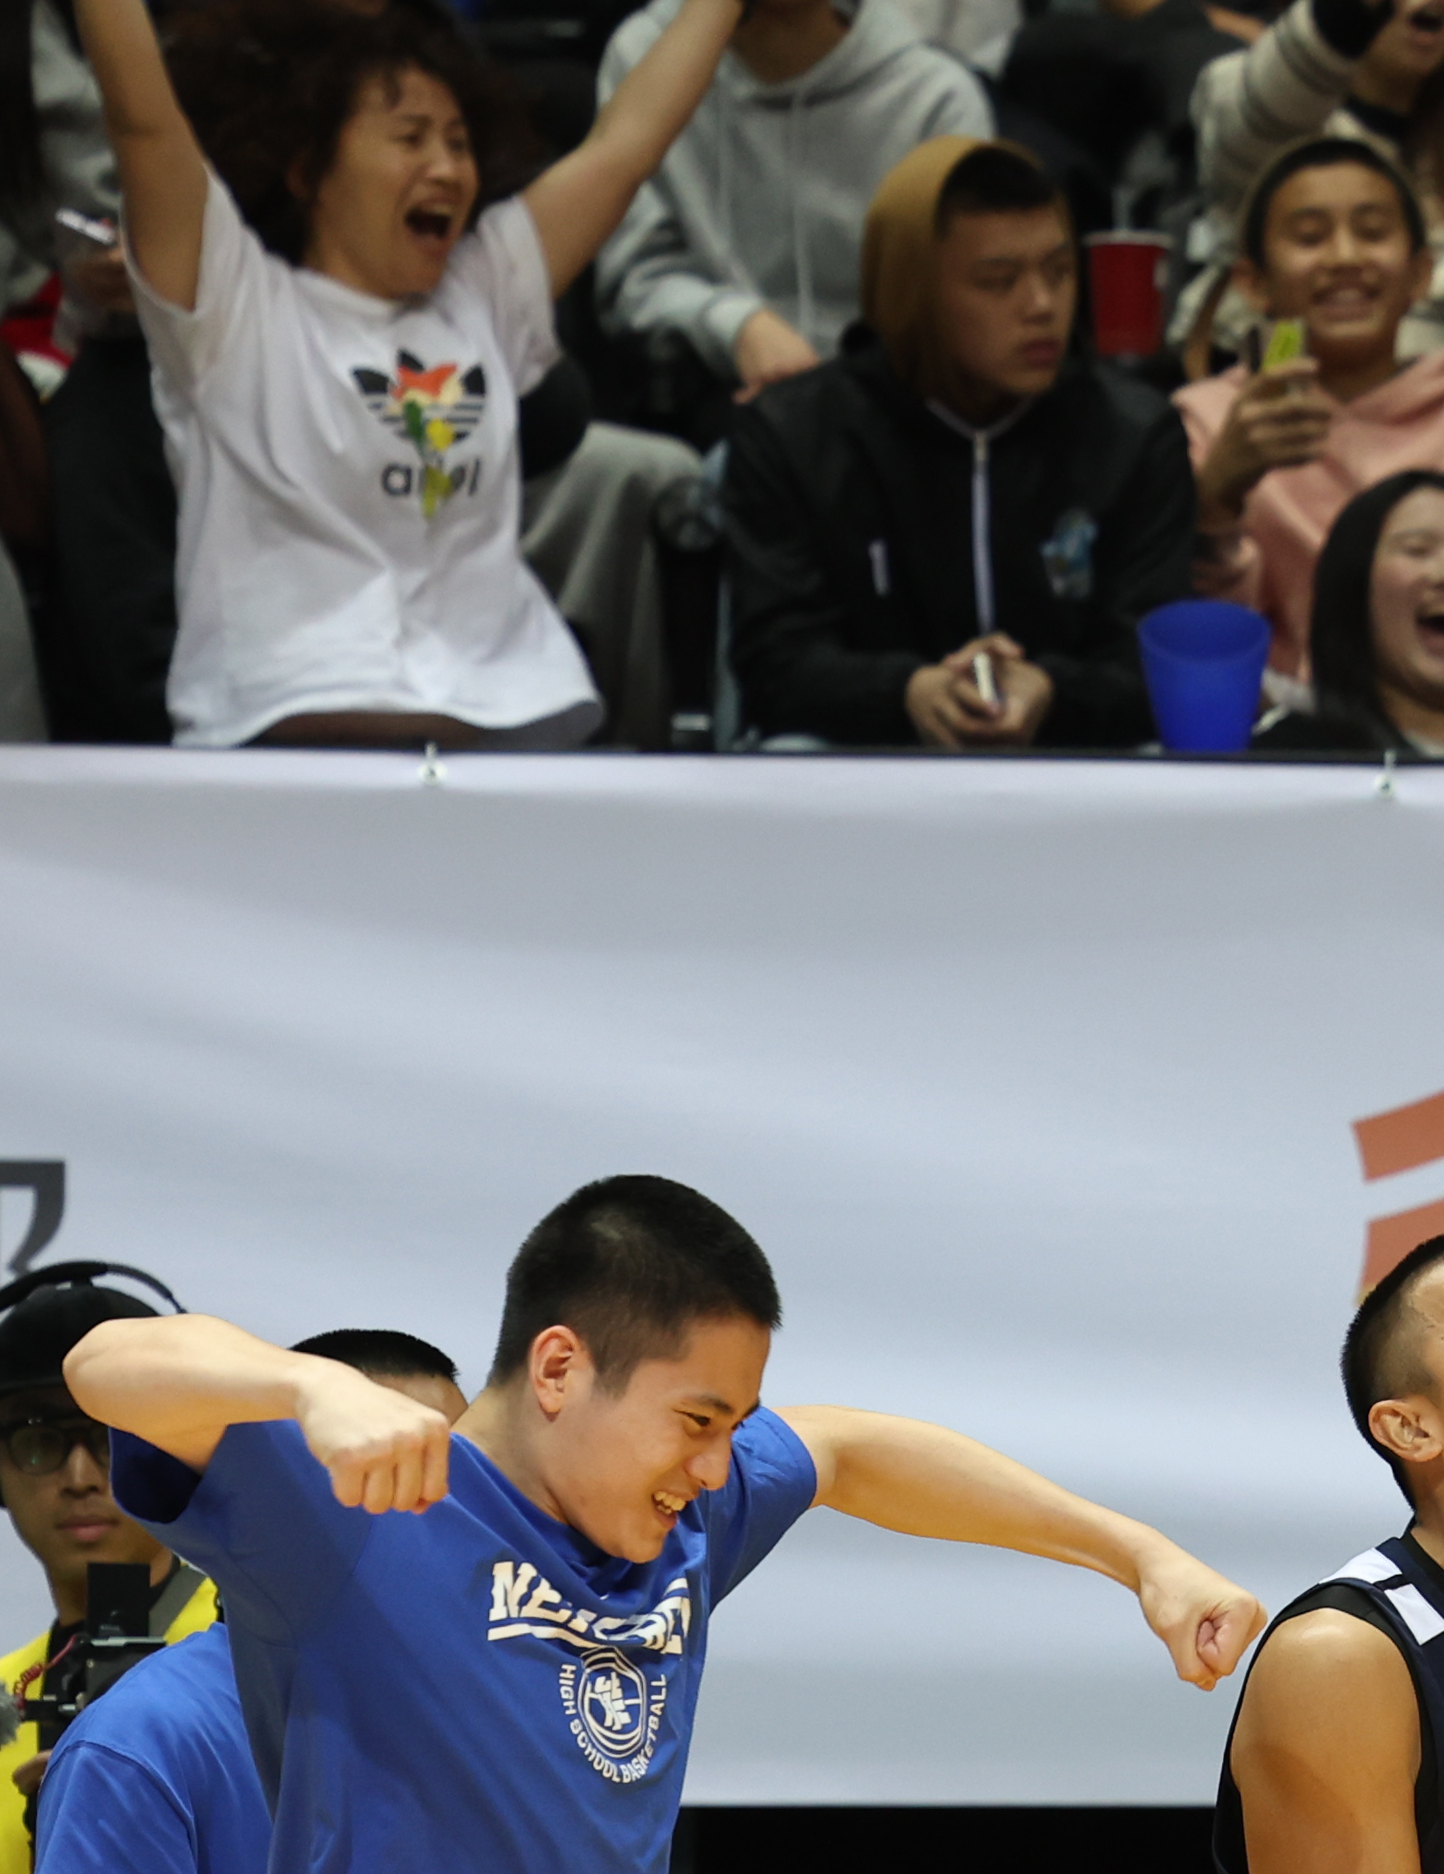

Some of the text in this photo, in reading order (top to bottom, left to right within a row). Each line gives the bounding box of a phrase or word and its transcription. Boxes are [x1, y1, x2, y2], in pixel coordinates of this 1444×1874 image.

[559, 1664, 667, 1784] HIGH SCHOOL BASKETBALL
